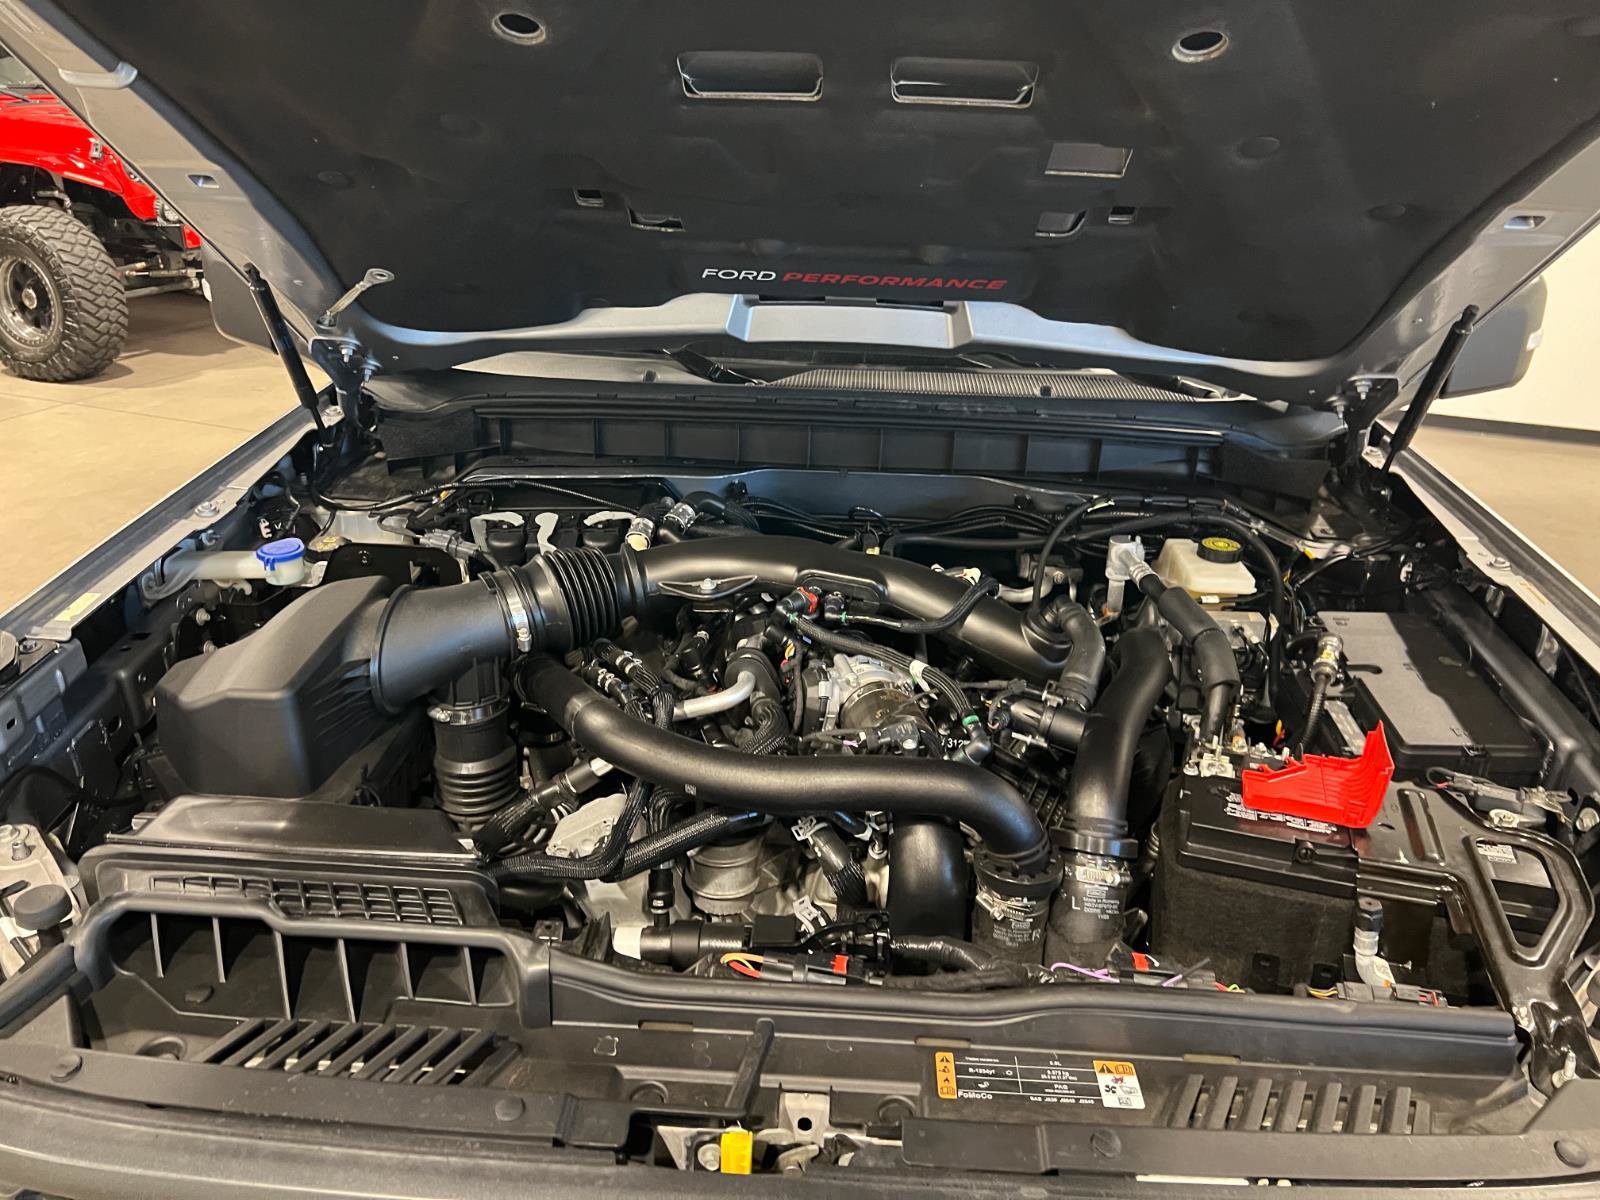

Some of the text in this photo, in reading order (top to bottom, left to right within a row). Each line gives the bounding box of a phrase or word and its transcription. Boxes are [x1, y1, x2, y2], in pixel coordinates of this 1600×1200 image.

[702, 268, 1007, 290] FORD PERFORMANCE
[1071, 895, 1081, 911] L
[1032, 928, 1042, 943] R
[958, 1091, 993, 1100] FoMoCo
